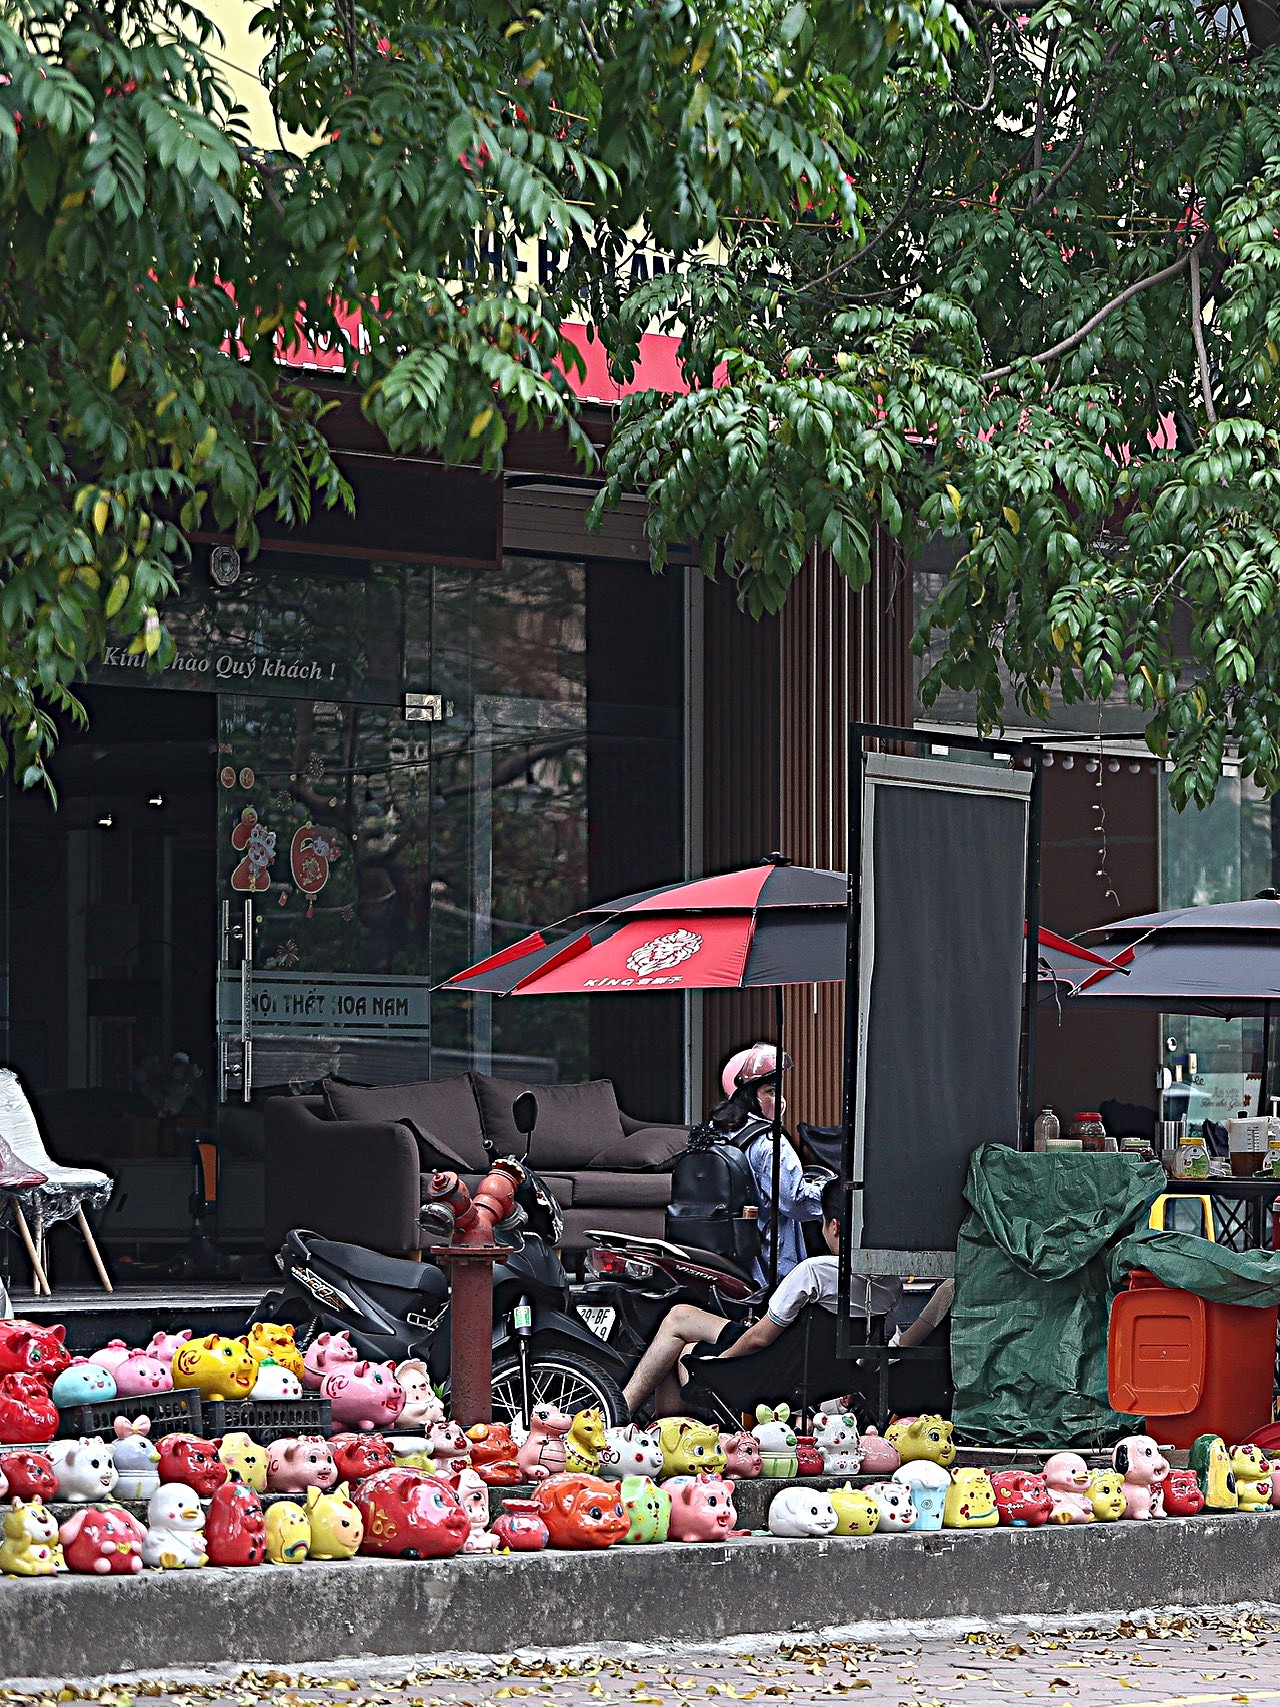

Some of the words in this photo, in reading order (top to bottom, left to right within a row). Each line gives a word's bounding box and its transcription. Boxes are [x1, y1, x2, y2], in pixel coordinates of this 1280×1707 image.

[102, 646, 148, 668] Kín
[216, 654, 257, 679] Quý
[261, 658, 322, 680] khách
[372, 996, 409, 1017] NAM
